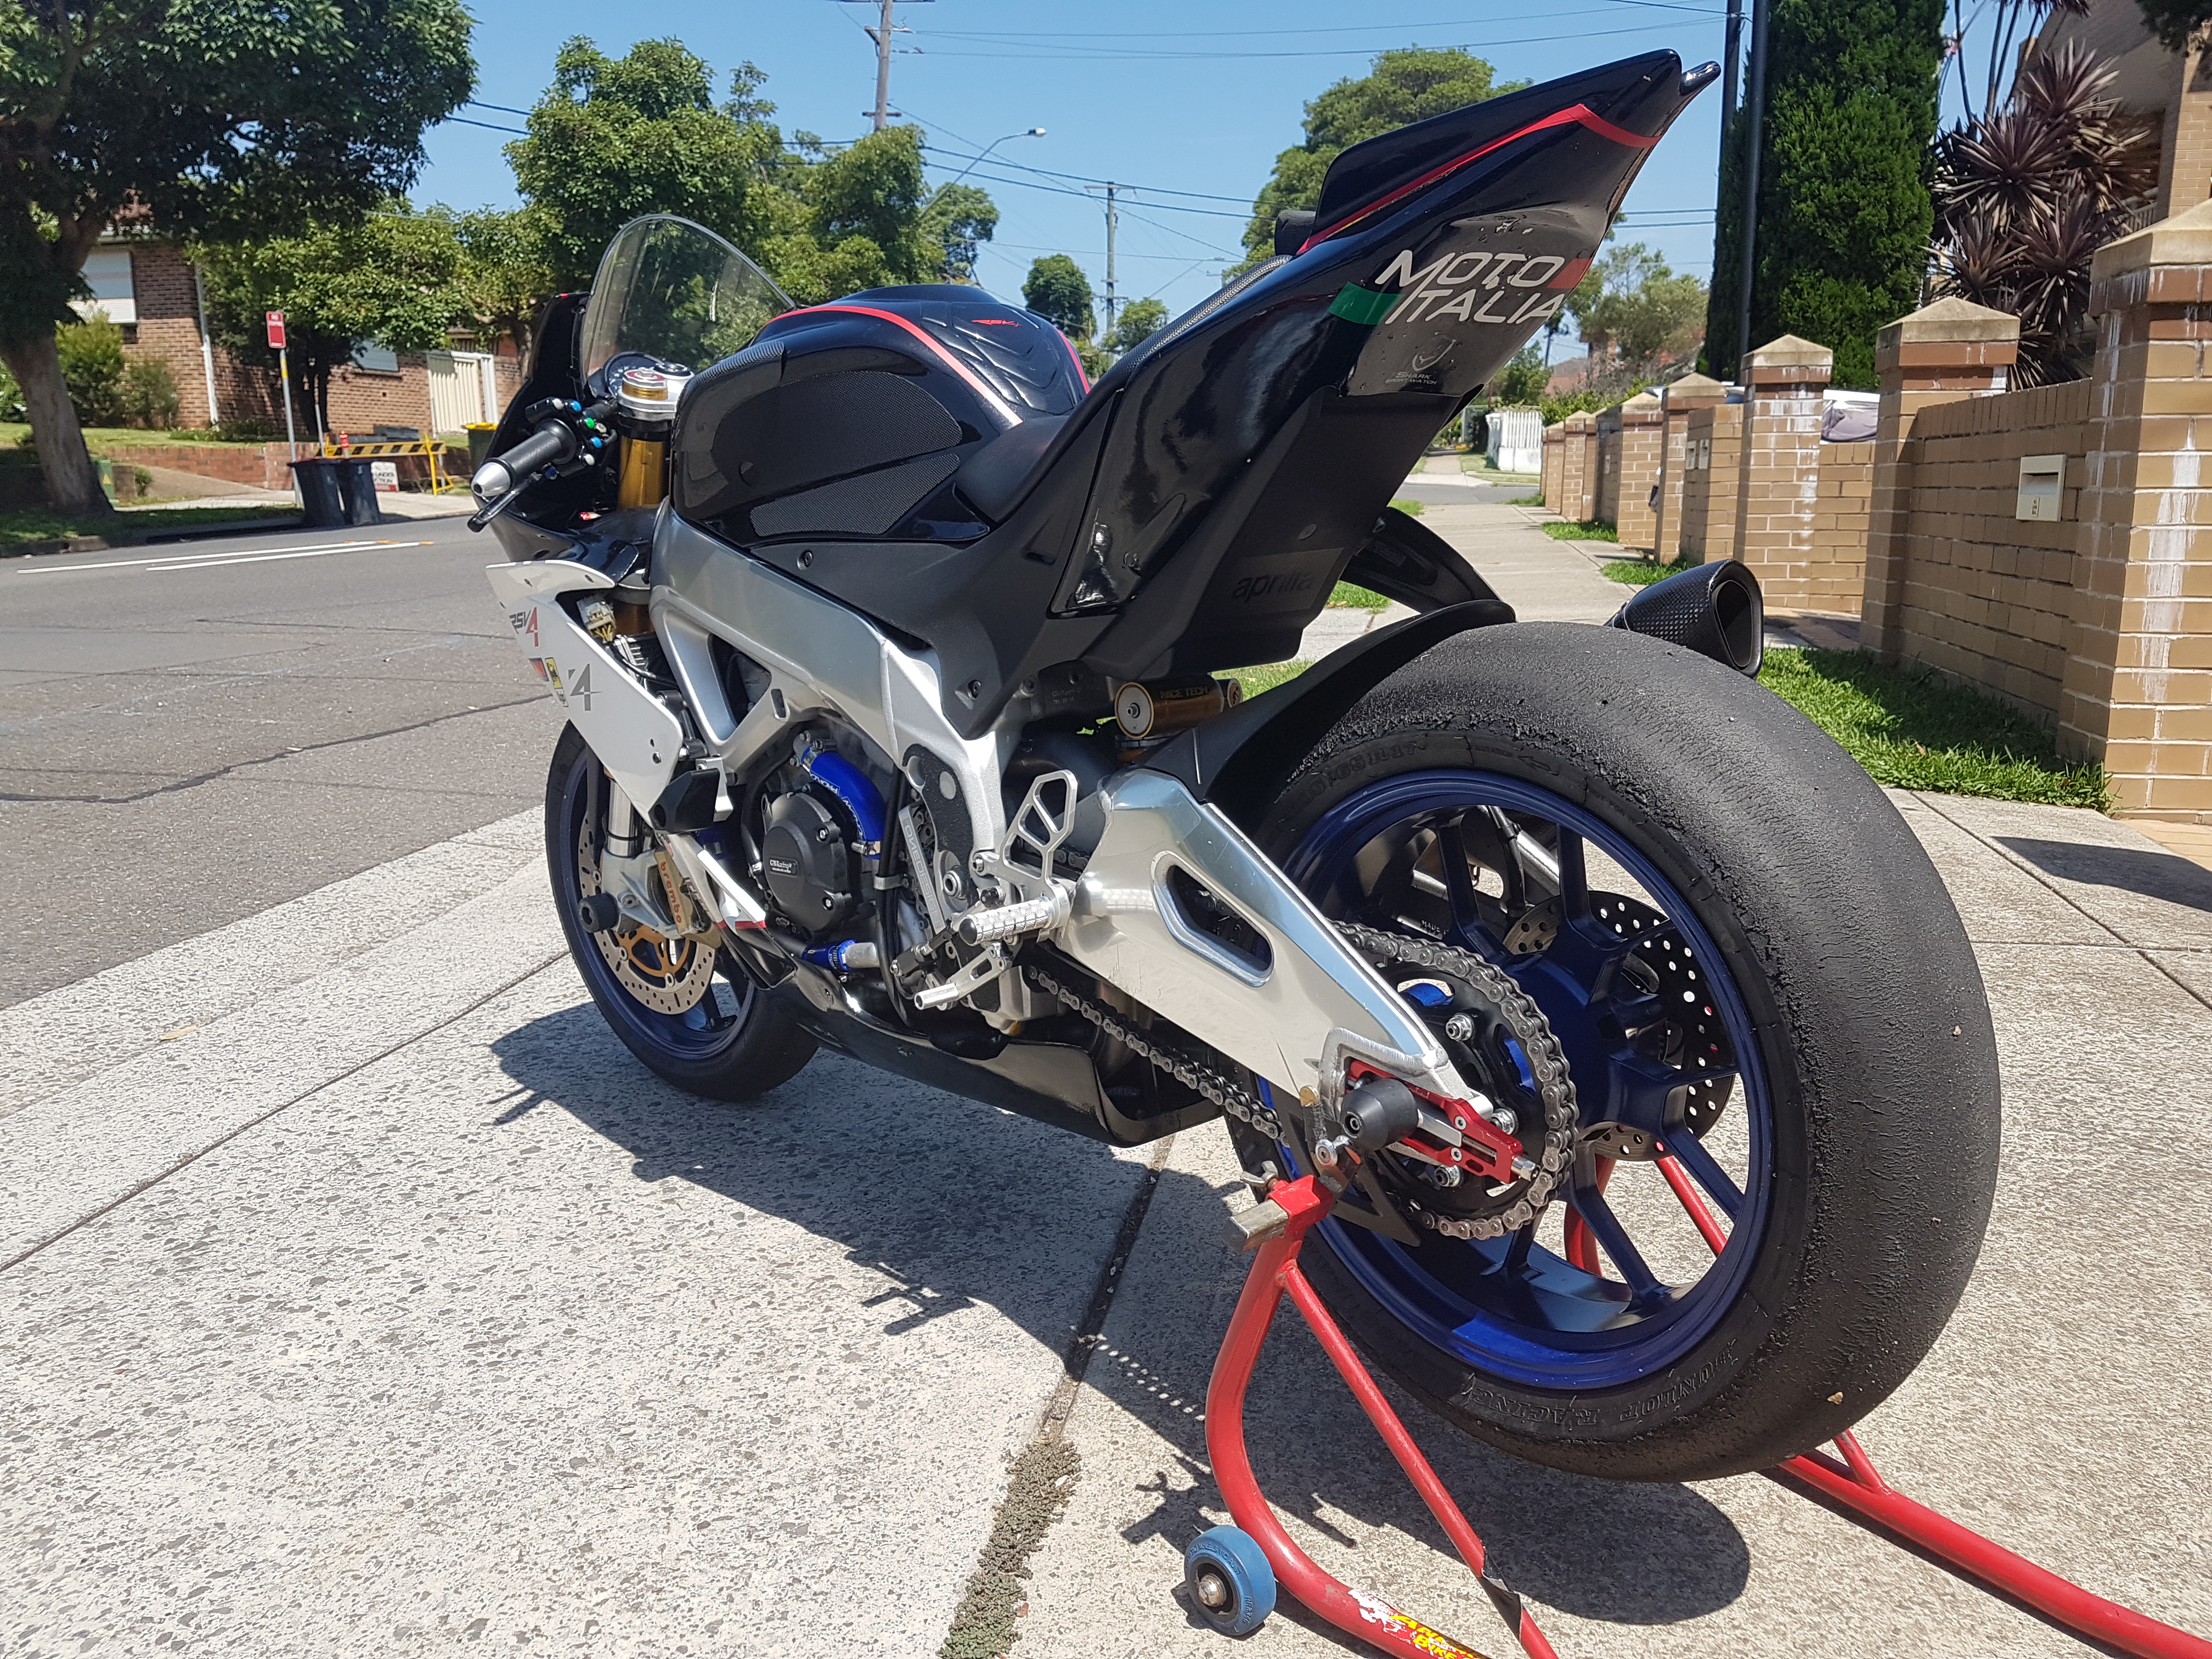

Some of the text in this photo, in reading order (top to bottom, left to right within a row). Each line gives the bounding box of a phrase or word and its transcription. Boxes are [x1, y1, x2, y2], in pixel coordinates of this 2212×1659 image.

[1375, 250, 1565, 288] MOTO
[1384, 287, 1565, 324] ITALIA
[1233, 573, 1312, 603] aprilia
[660, 861, 682, 924] brembo
[1472, 1386, 1600, 1426] RACING
